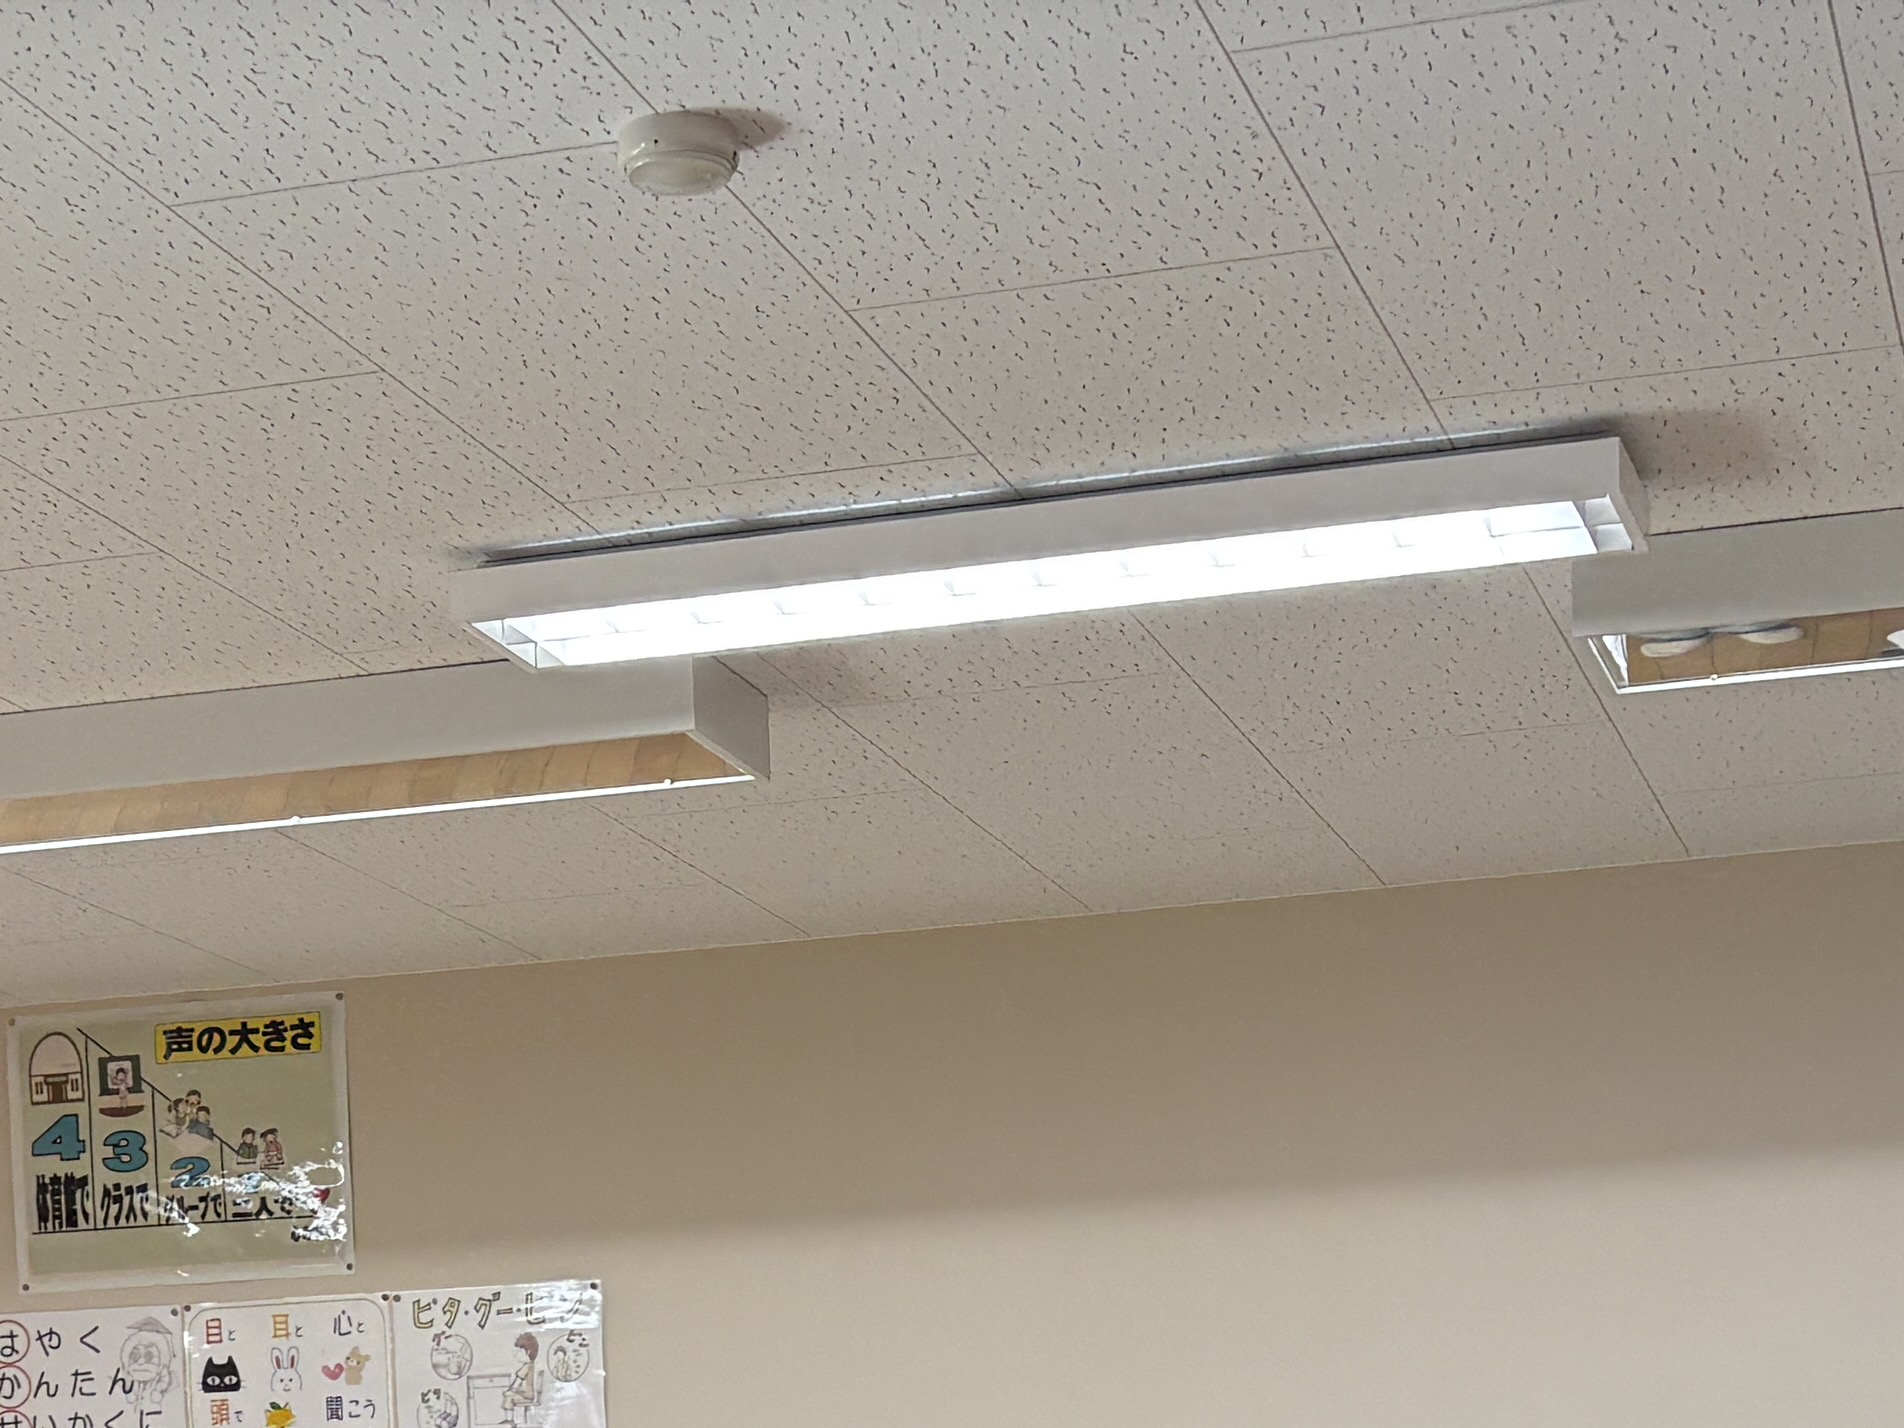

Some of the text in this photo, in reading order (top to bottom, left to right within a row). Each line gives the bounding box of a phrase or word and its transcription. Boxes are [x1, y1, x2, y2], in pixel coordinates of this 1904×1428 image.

[163, 1017, 316, 1060] 声の大きさ
[31, 1114, 86, 1161] 4
[101, 1130, 149, 1173] 3
[205, 1309, 366, 1345] 目と 耳と 心と
[325, 1395, 377, 1422] 聞こう
